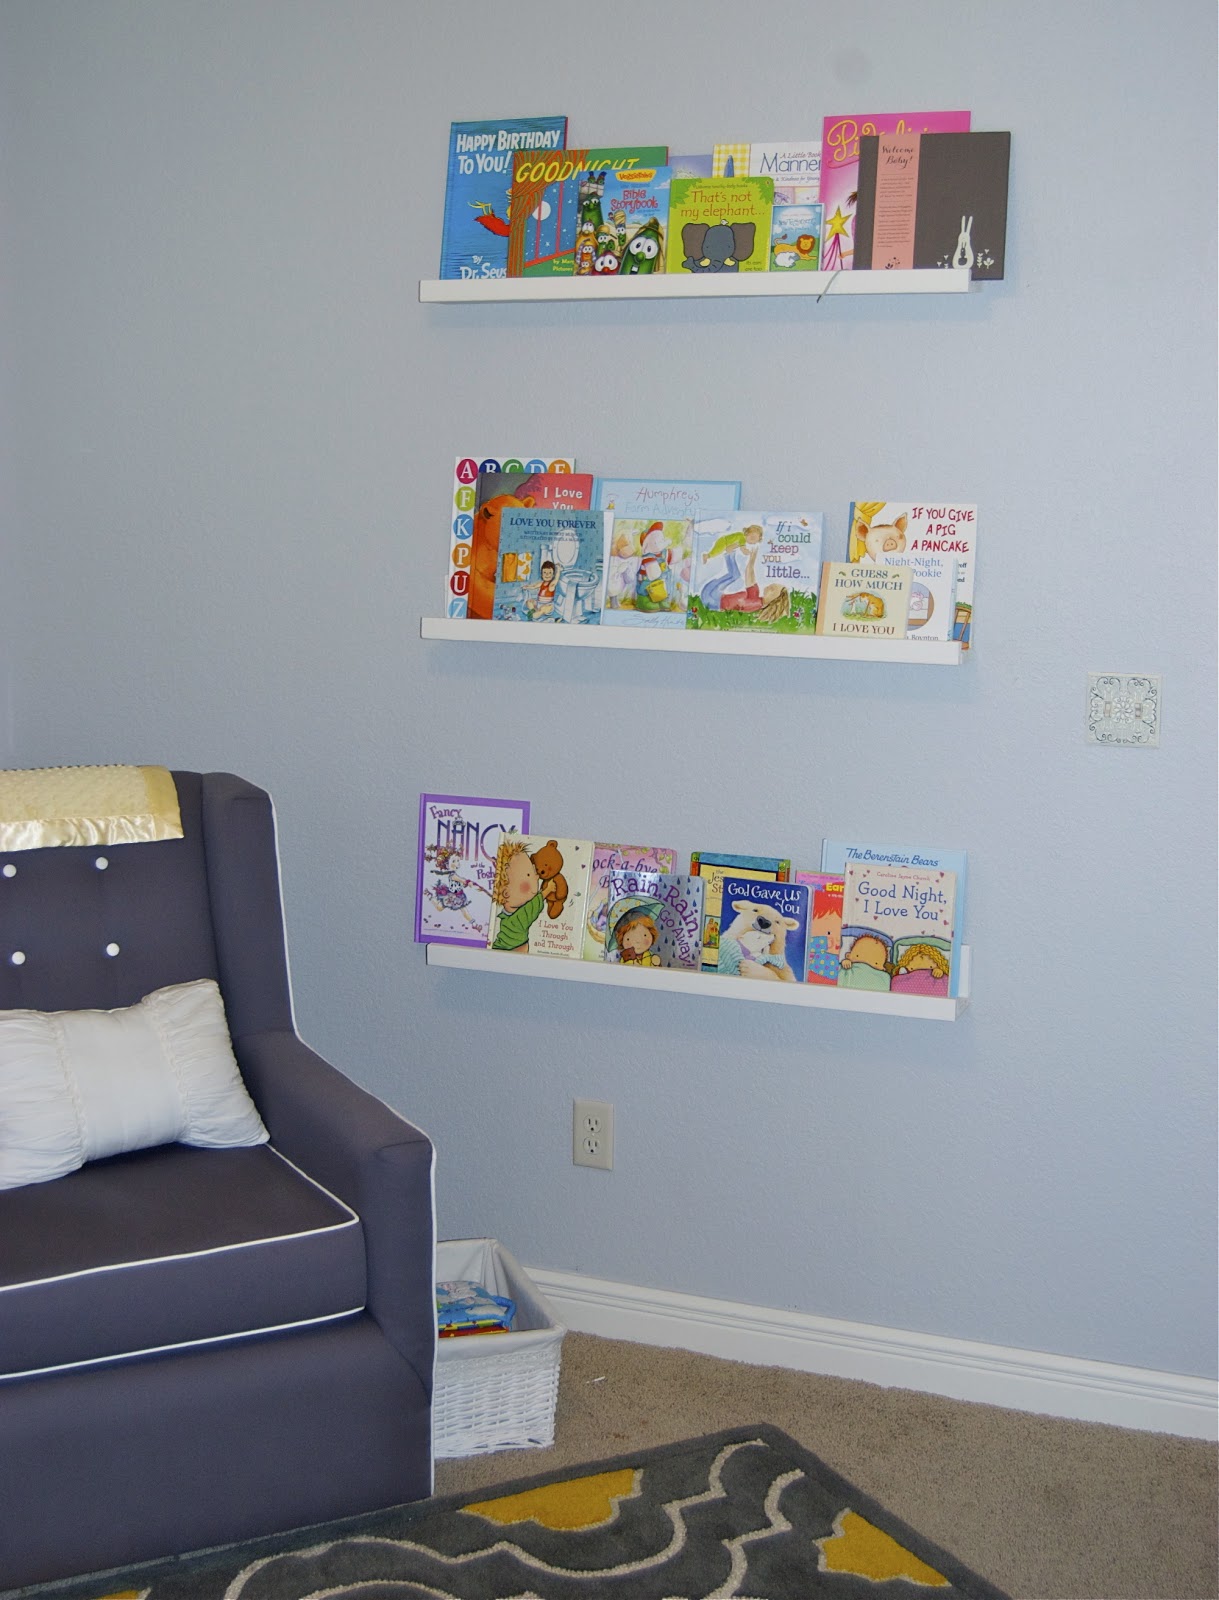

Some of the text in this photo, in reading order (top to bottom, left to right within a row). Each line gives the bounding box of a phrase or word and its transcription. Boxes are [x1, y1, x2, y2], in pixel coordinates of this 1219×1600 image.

[456, 130, 561, 153] HAPPY BIRTHDAY
[882, 145, 914, 154] Welcome
[458, 151, 512, 174] TO YOU!
[760, 153, 821, 173] Manner
[623, 189, 647, 200] Bible
[691, 189, 752, 203] That's not
[610, 196, 659, 214] Storybook
[680, 208, 700, 221] my
[481, 262, 508, 279] Seus
[460, 462, 474, 478] A
[460, 490, 472, 508] F
[544, 487, 583, 499] I Love
[636, 486, 700, 506] Humphrey's
[912, 507, 975, 522] IF YOU GIVE
[456, 518, 470, 535] K
[510, 517, 597, 529] LOVE YOU FOREVER
[776, 521, 785, 533] If
[926, 524, 956, 537] A PIG
[778, 533, 811, 543] could
[770, 543, 799, 555] keep
[911, 540, 969, 553] A PANCAKE
[456, 548, 469, 566] P
[762, 555, 781, 564] you
[884, 557, 944, 569] Night-Night,
[766, 565, 810, 579] little...
[851, 568, 889, 579] GUESS
[453, 575, 468, 593] U
[835, 578, 903, 591] HOW MUCH
[832, 623, 896, 635] I LOVE YOU
[429, 805, 462, 820] Fancy
[592, 854, 658, 874] ock-a-bye
[846, 848, 939, 867] The Berenstain Bears
[707, 872, 724, 884] Jes
[611, 875, 662, 899] Rain,
[728, 882, 750, 896] God
[751, 885, 782, 901] Gave
[784, 888, 801, 901] Us
[826, 883, 844, 893] Ear
[858, 881, 947, 905] Good Night,
[663, 885, 699, 938] Rain,
[775, 900, 801, 914] You
[864, 899, 939, 921] I Love You
[544, 920, 559, 929] Love
[561, 922, 574, 931] You
[542, 930, 568, 941] Through
[660, 910, 696, 967] Go Away!
[534, 940, 574, 952] and Through
